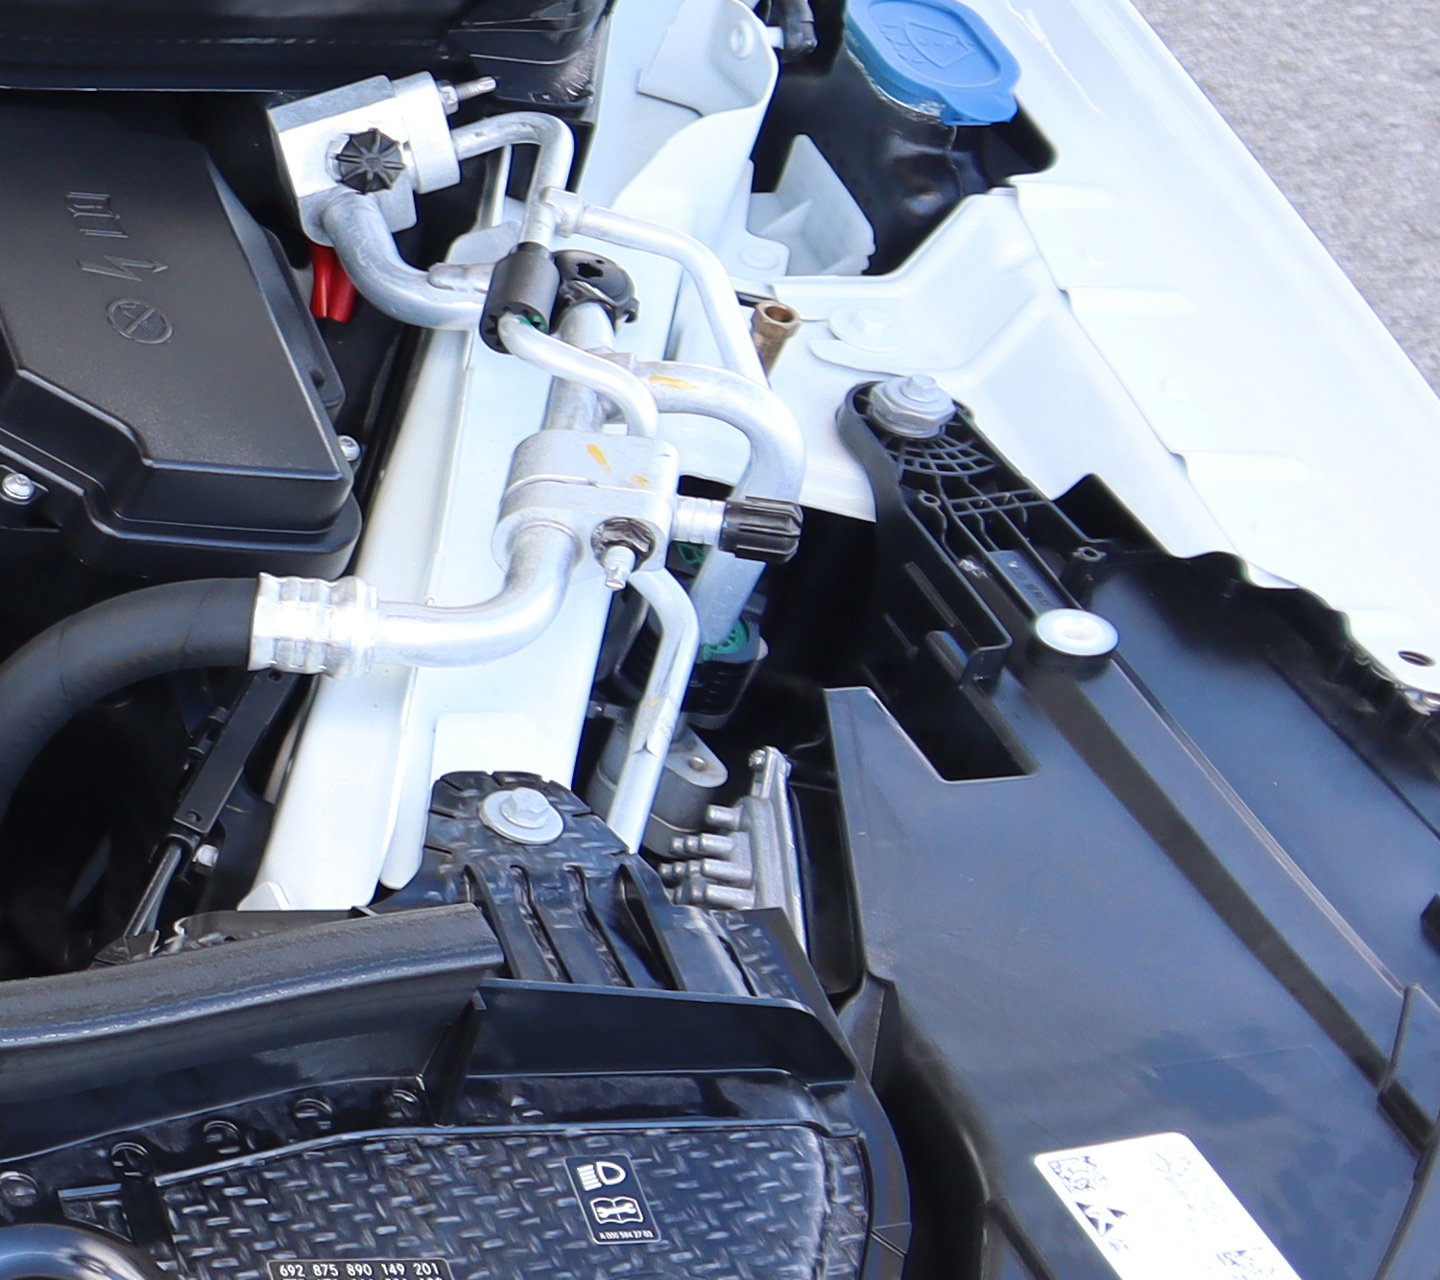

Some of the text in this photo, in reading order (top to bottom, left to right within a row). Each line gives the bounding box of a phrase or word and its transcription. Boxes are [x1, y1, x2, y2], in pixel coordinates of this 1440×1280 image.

[280, 1262, 439, 1277] 692 875 890 149 201
